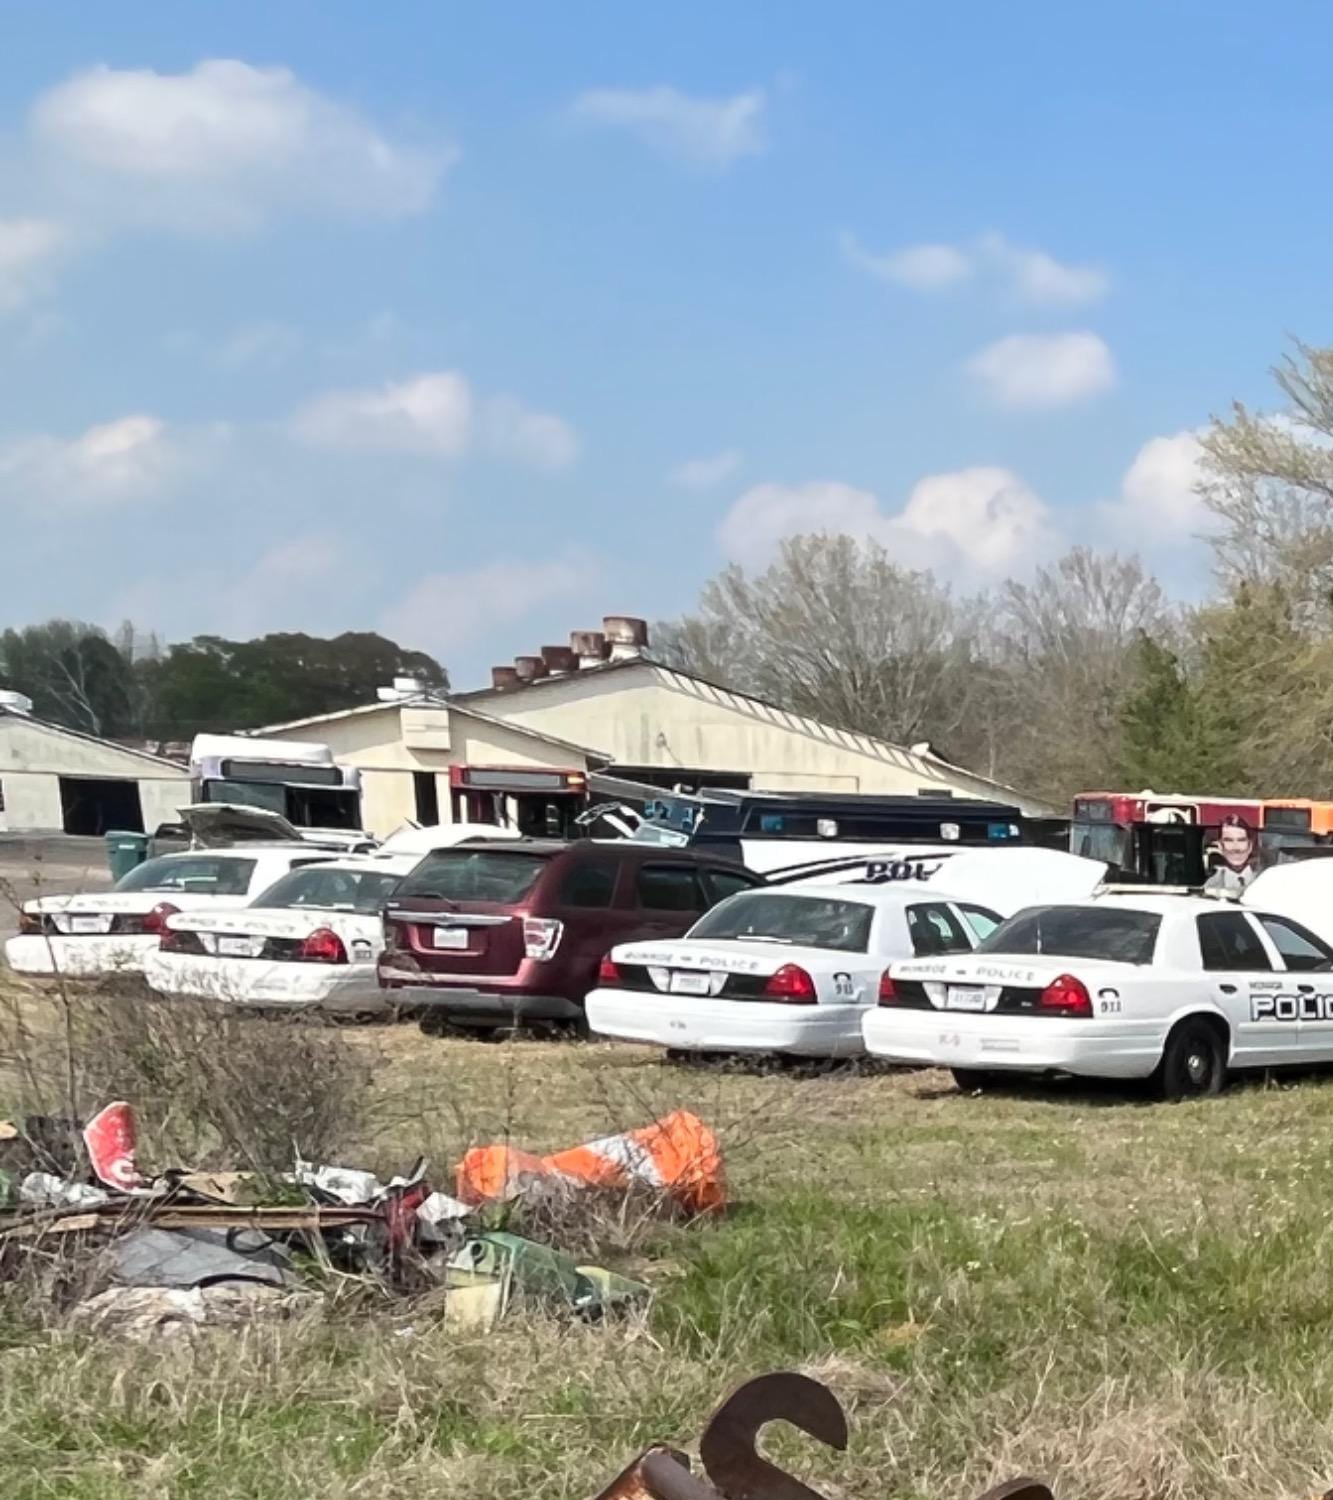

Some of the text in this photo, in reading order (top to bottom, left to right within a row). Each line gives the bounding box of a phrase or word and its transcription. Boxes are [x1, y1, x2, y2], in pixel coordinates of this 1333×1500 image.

[700, 955, 760, 969] POLICE
[976, 965, 1035, 982] POLICE
[1101, 1000, 1122, 1013] 911
